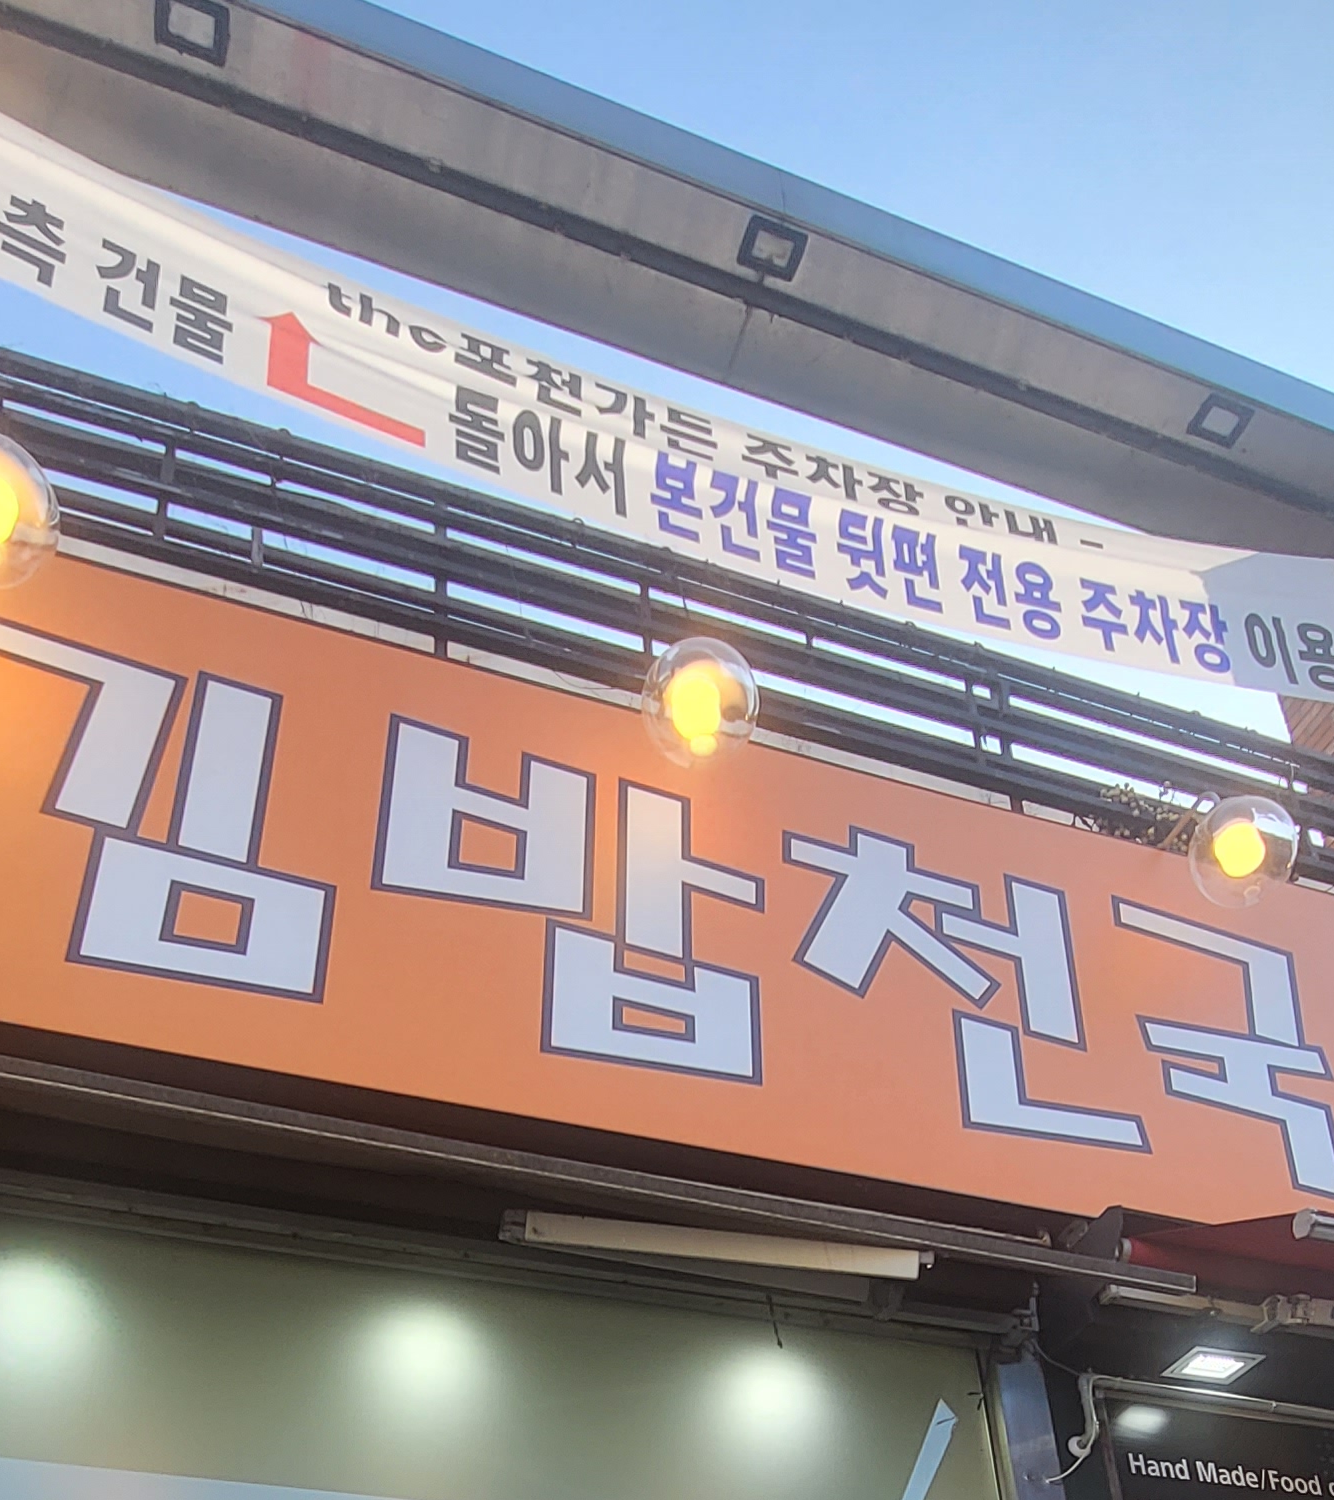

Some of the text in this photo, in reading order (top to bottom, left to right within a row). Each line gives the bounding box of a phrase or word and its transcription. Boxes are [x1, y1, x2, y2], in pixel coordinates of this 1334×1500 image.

[97, 239, 234, 365] 건물
[448, 384, 629, 518] 돌아서
[650, 450, 819, 580] 본건물
[836, 509, 943, 614] 뒷편
[958, 546, 1063, 641] 전용
[1081, 580, 1233, 674] 주차장
[740, 432, 924, 517] 주차장
[1128, 1453, 1190, 1484] Hand
[1196, 1461, 1322, 1499] Made/Food
